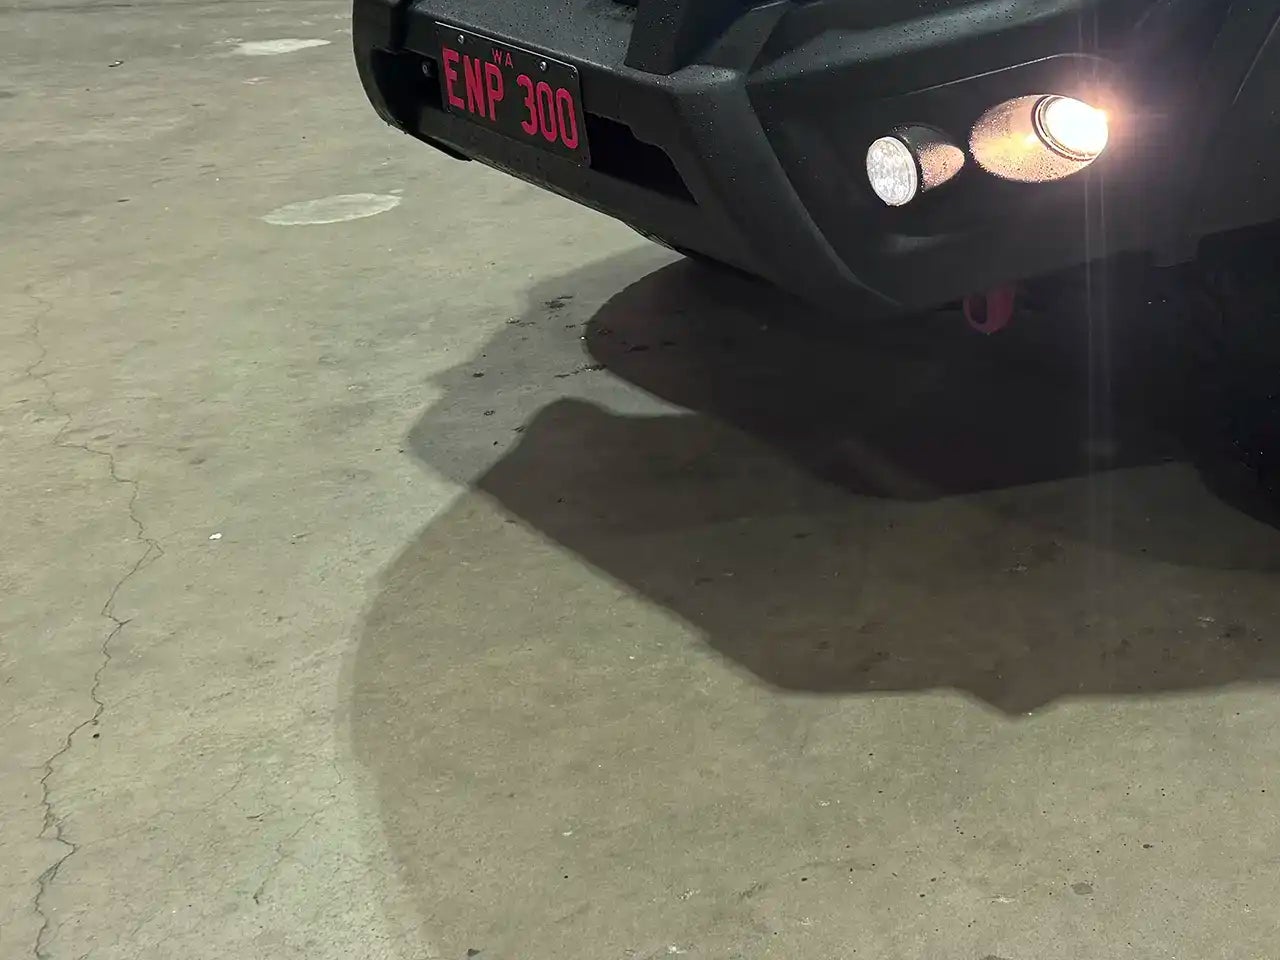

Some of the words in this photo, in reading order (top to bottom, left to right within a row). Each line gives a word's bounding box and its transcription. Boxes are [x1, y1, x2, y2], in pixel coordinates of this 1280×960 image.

[491, 47, 514, 70] WA
[442, 46, 504, 122] ENP
[516, 74, 579, 149] 300
